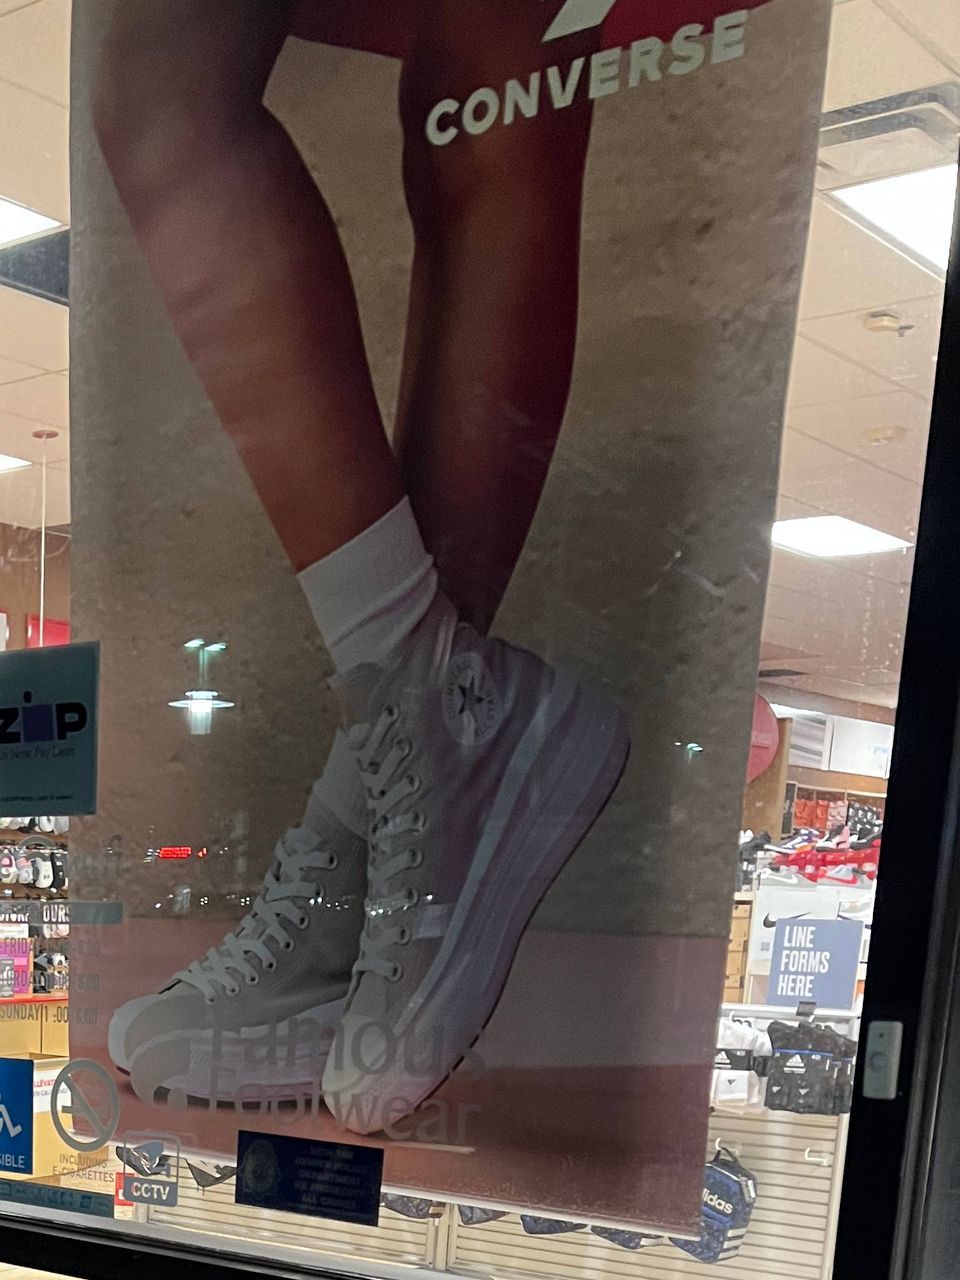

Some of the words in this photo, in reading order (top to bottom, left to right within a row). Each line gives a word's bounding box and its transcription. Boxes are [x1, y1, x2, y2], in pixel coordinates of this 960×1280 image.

[425, 9, 749, 146] CONVERSE
[783, 925, 816, 948] LINE
[780, 950, 831, 974] FORMS
[777, 974, 815, 997] HERE
[0, 1003, 39, 1021] SUNDAY
[131, 1181, 170, 1201] CCTV
